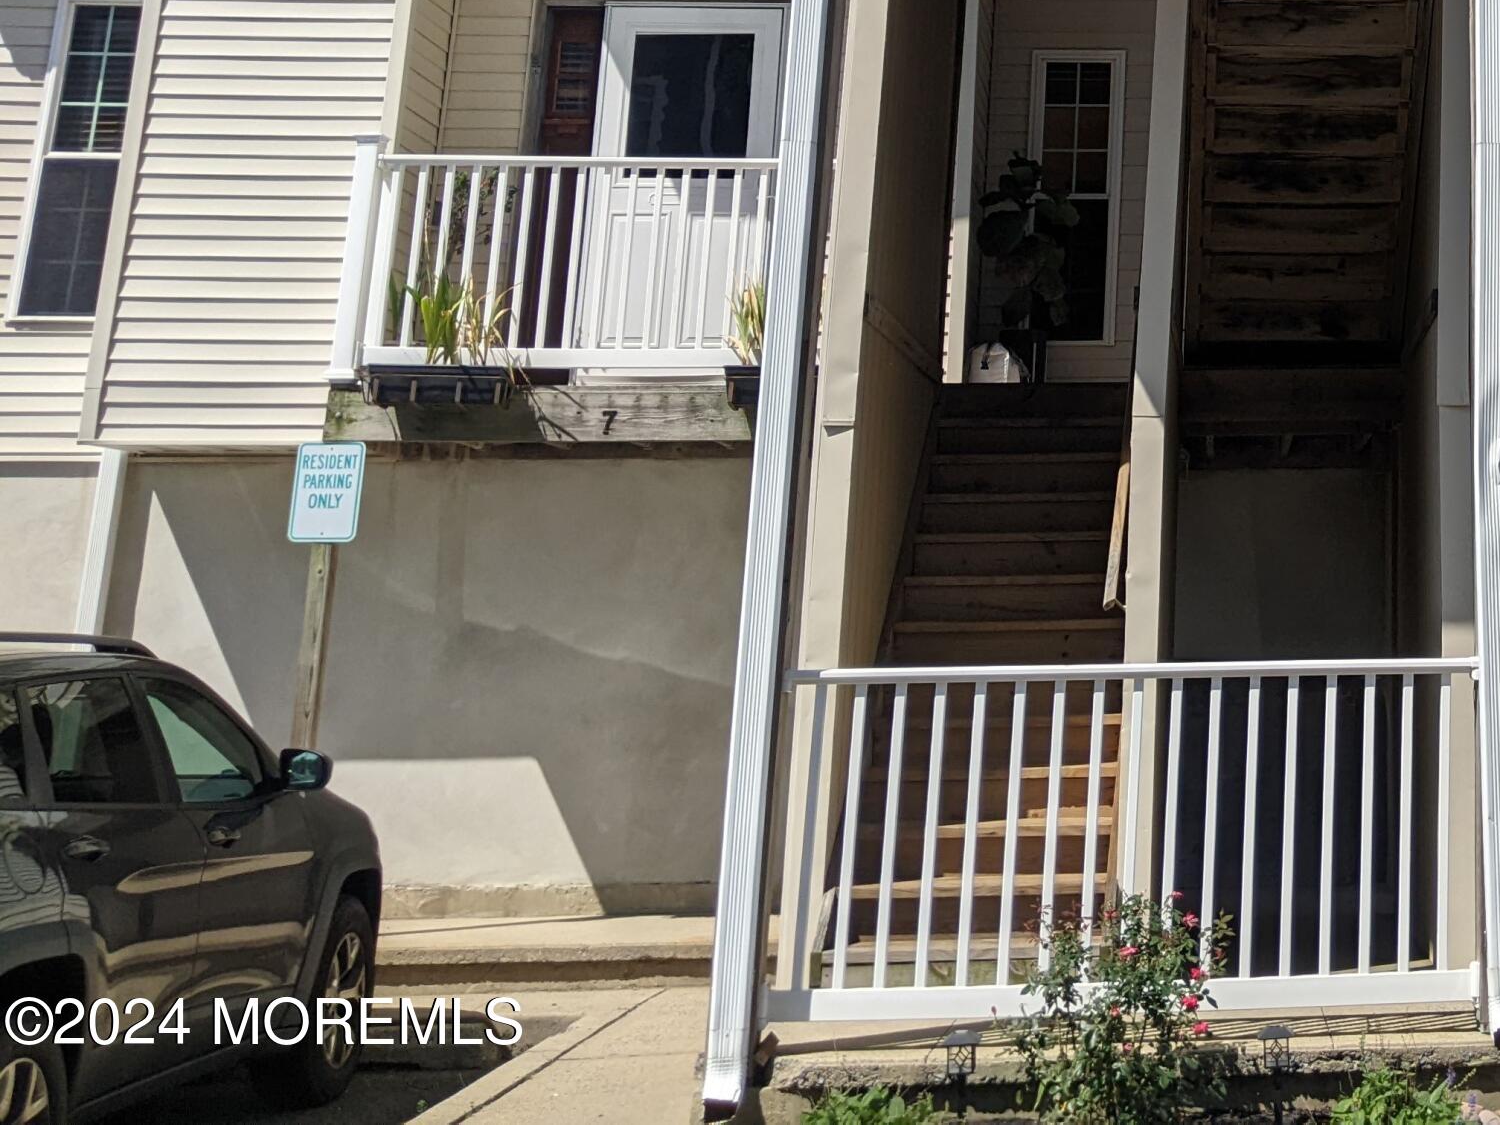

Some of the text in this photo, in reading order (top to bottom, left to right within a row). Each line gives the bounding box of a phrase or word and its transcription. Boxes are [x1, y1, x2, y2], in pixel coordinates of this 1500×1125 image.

[602, 410, 618, 435] 7
[302, 454, 358, 470] RESIDENT
[303, 474, 352, 489] PARKING
[308, 493, 343, 509] ONLY
